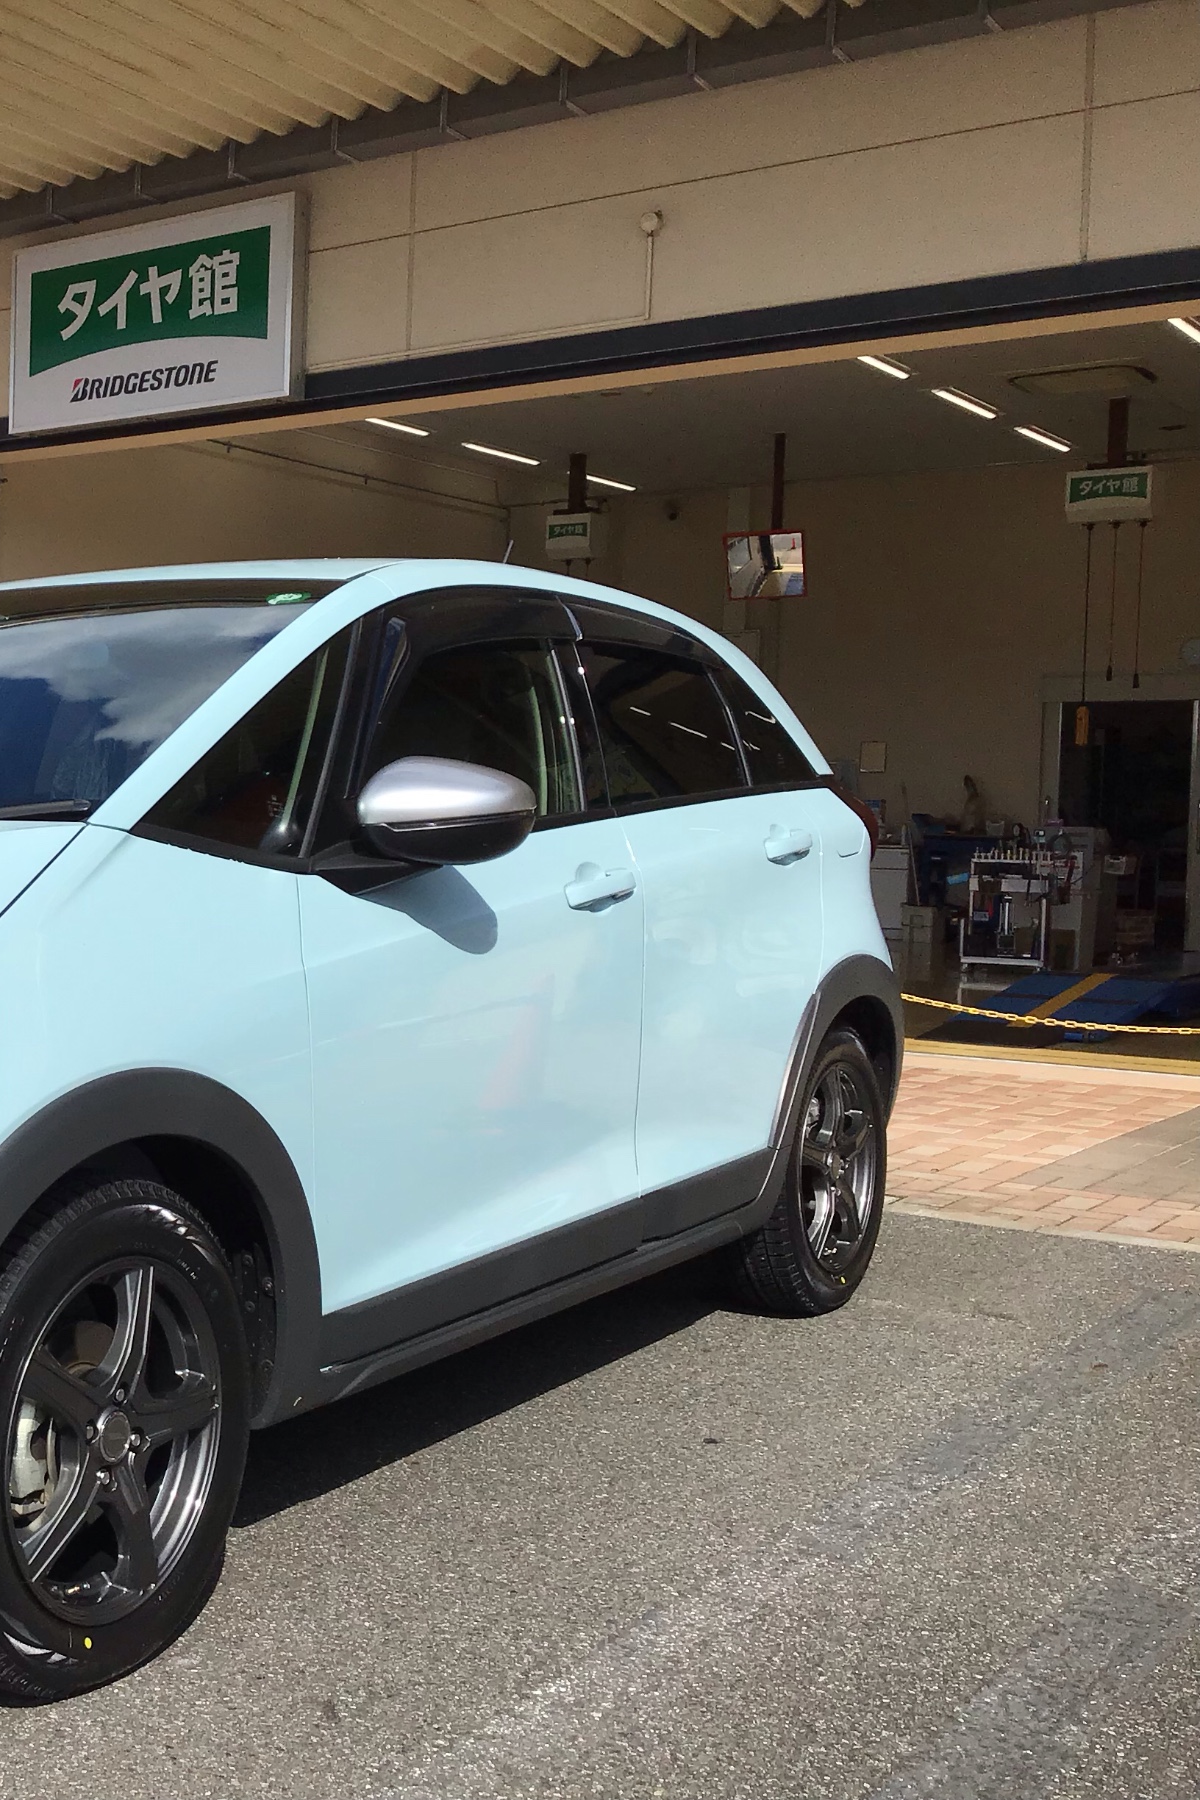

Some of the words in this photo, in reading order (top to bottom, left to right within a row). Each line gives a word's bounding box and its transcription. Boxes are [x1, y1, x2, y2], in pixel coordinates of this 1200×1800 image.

[57, 249, 240, 341] タイヤ館
[69, 360, 218, 402] BRIDGESTONE
[1079, 477, 1140, 495] タイヤ館
